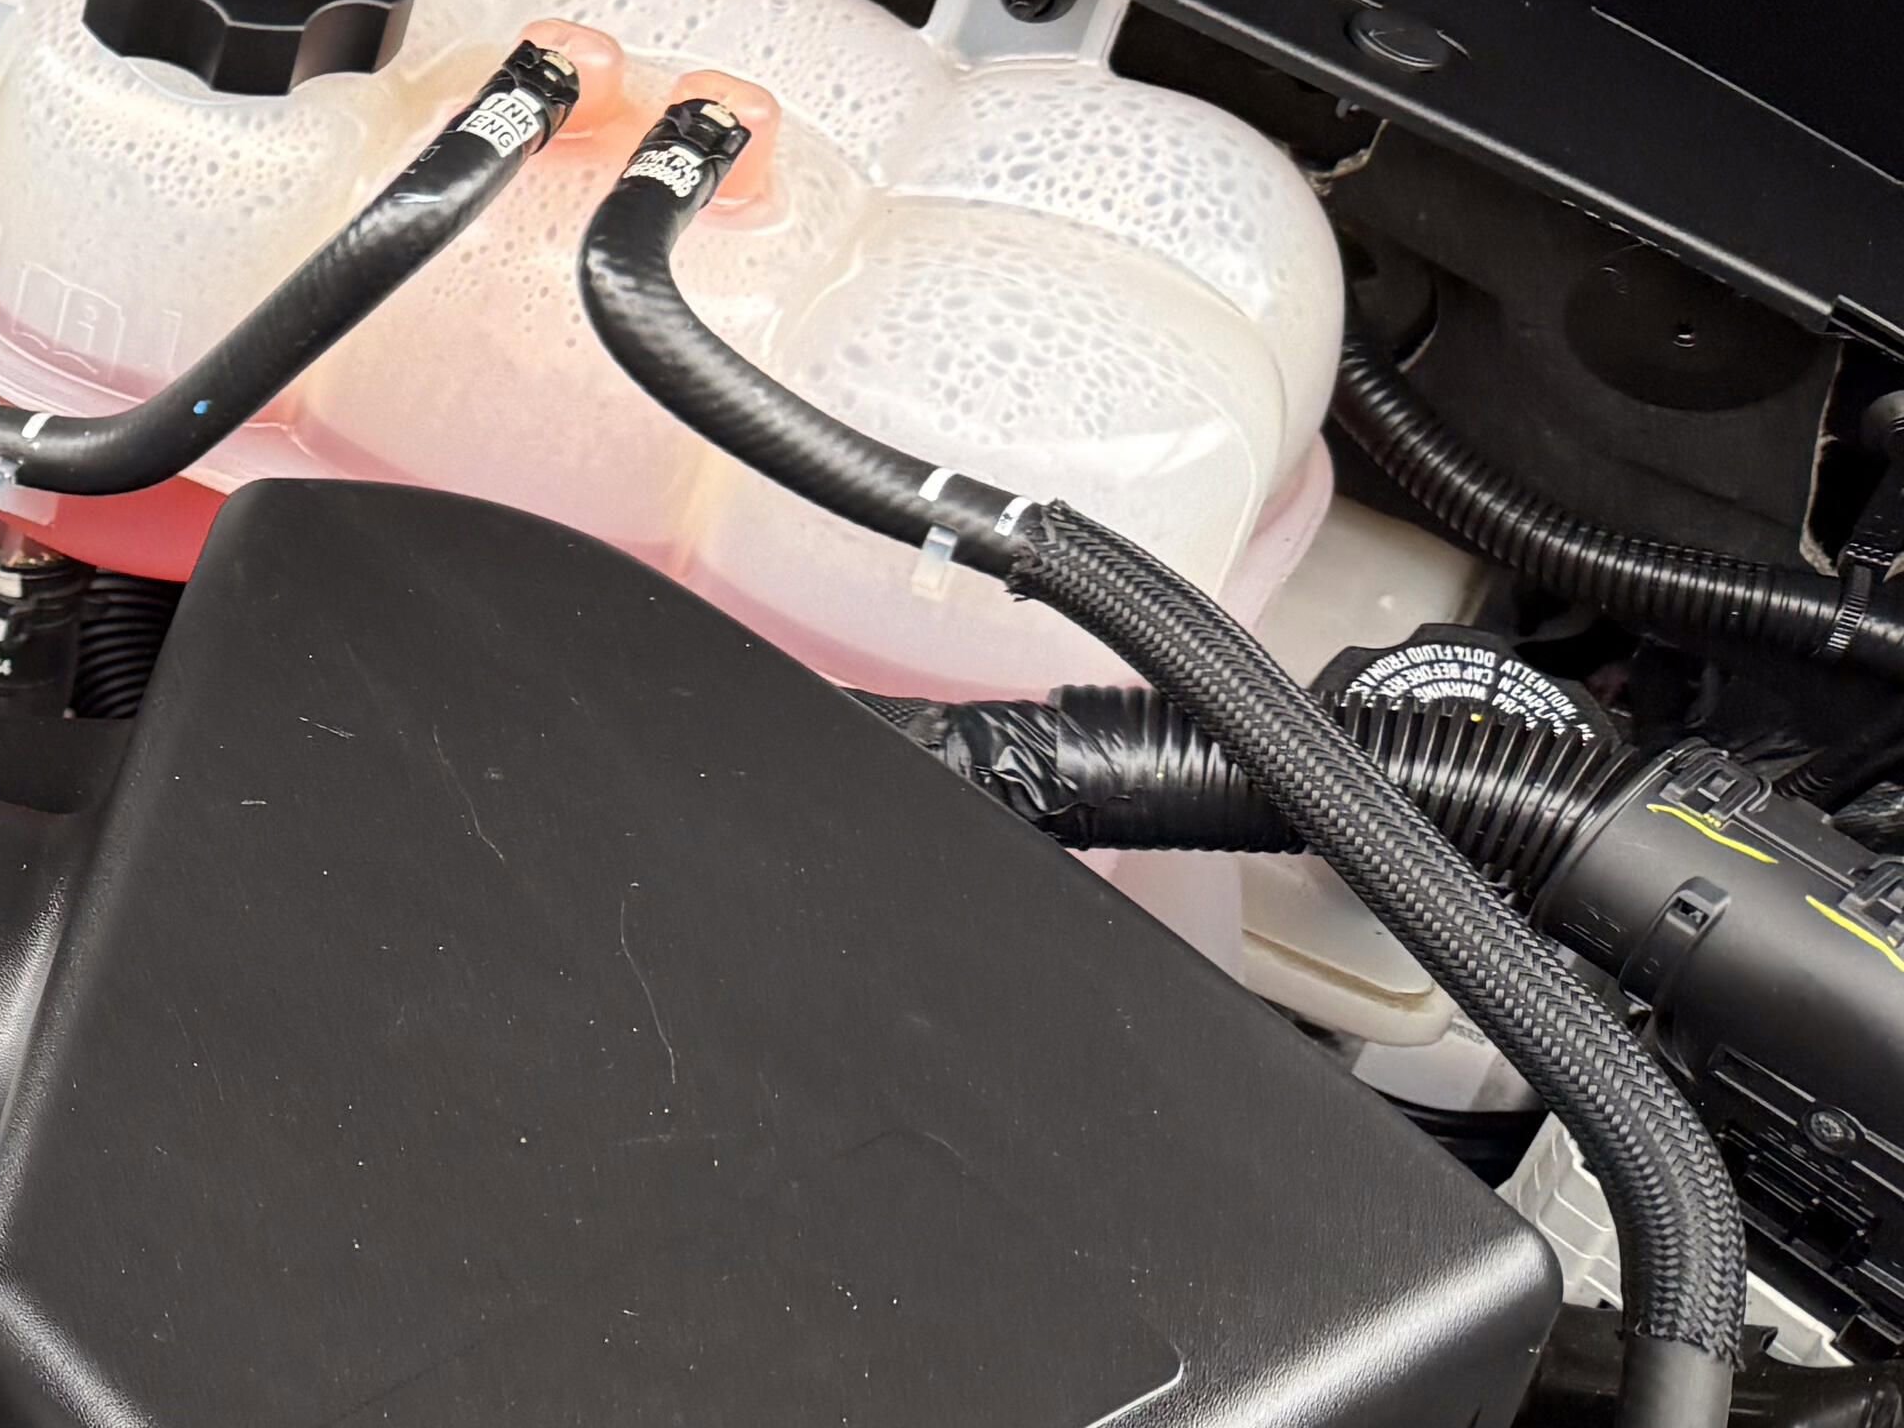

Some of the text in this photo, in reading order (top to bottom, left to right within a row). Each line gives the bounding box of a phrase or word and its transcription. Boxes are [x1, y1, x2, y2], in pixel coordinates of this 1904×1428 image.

[465, 113, 515, 149] ENG
[1405, 643, 1453, 665] FLUID
[1411, 681, 1488, 703] WARNING
